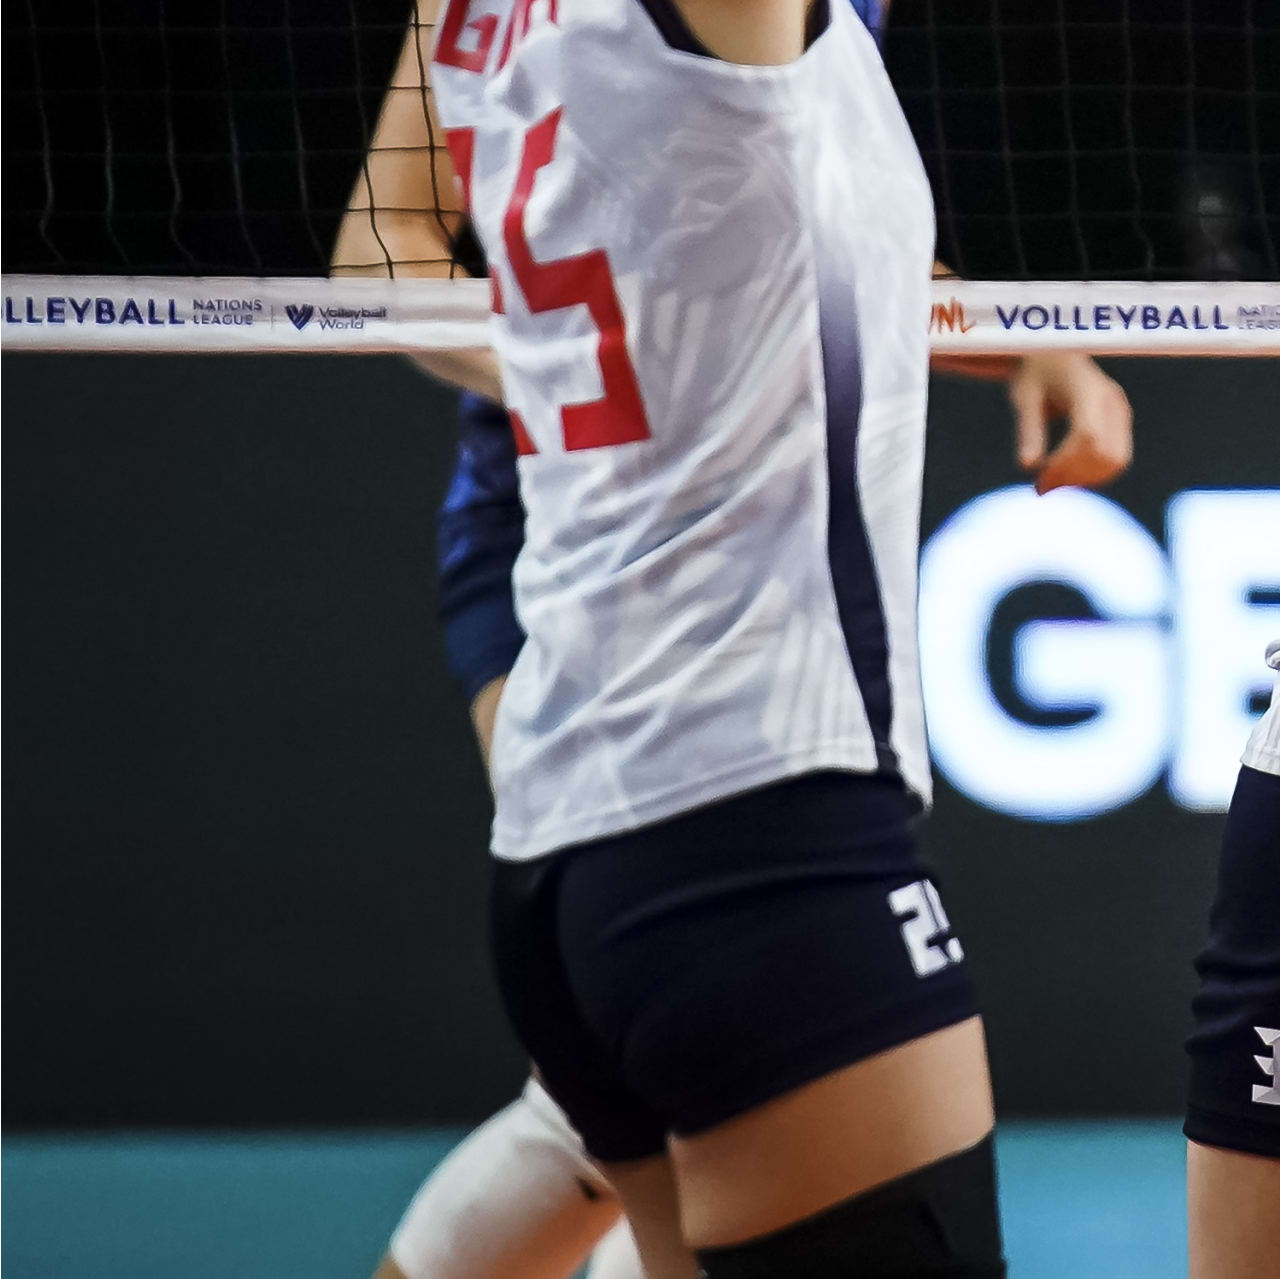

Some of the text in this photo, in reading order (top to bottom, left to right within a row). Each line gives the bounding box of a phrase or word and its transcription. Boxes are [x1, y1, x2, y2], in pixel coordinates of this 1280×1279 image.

[1, 296, 262, 325] LLEYBALL NATIONS
[193, 313, 253, 326] LEAGUE
[995, 304, 1229, 331] VOLLEYBALL
[320, 319, 364, 331] World
